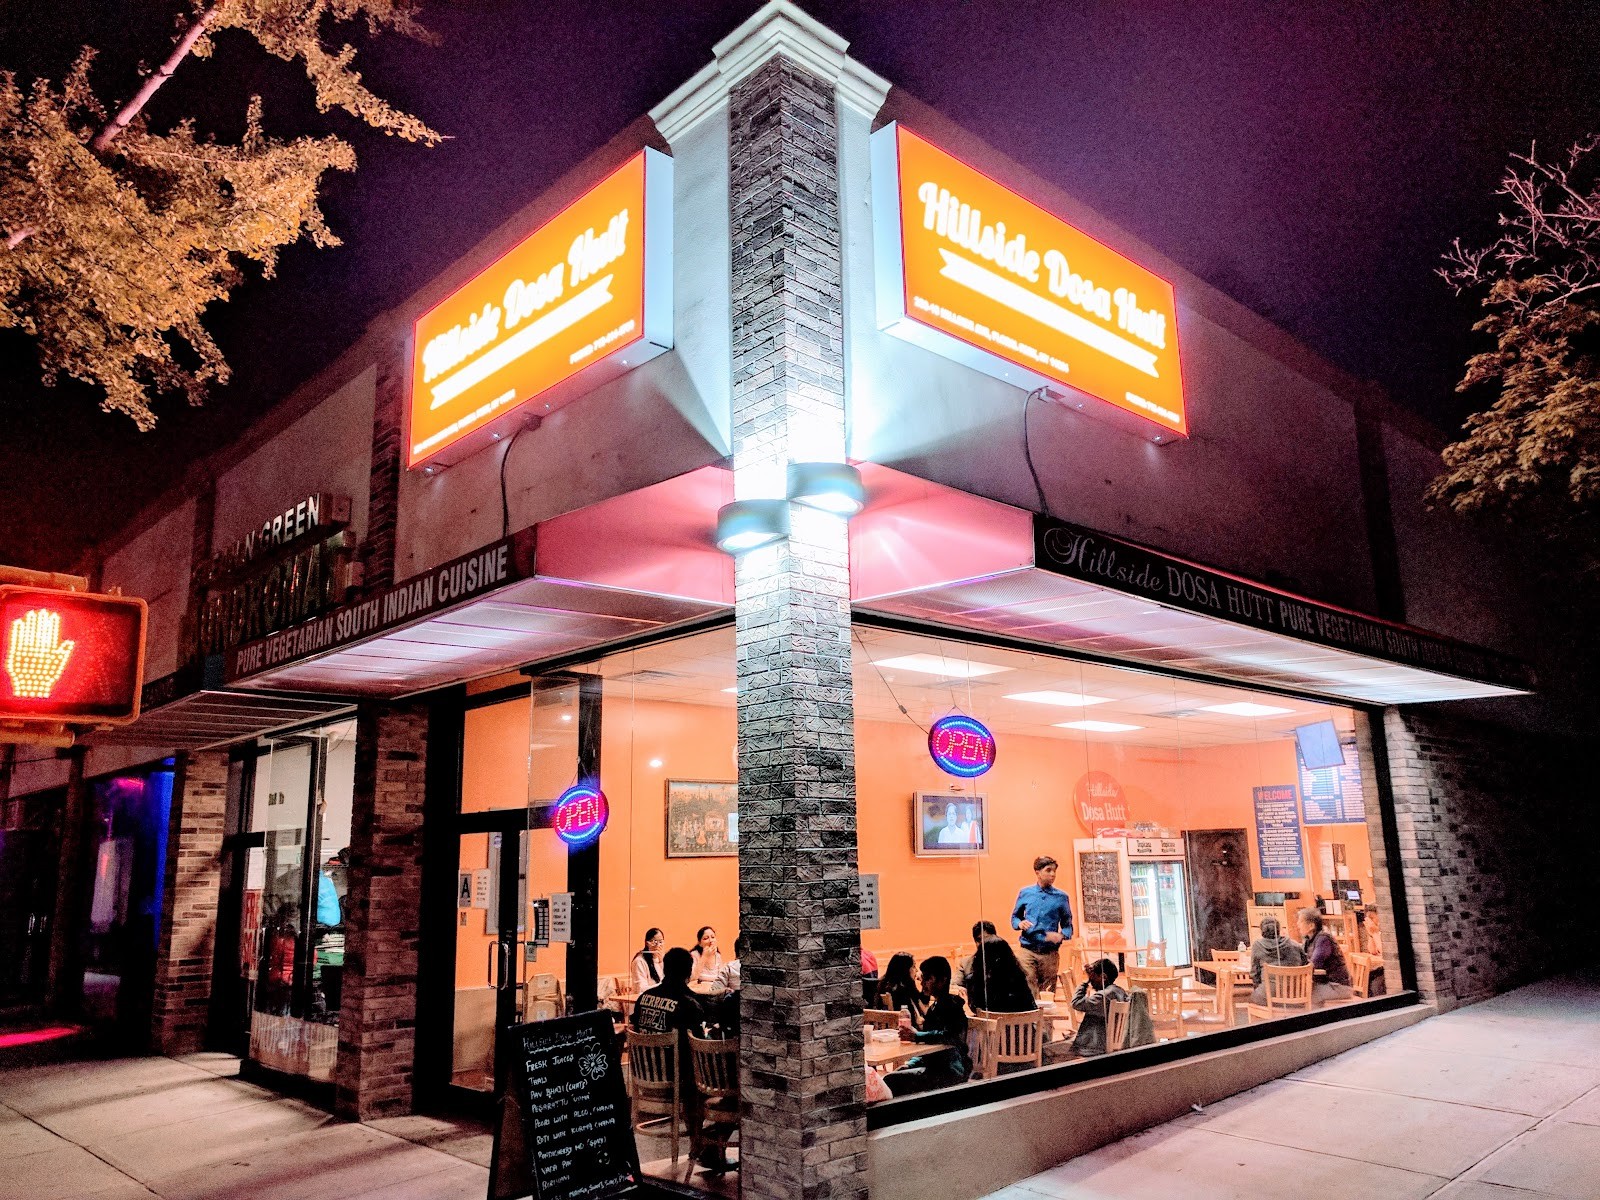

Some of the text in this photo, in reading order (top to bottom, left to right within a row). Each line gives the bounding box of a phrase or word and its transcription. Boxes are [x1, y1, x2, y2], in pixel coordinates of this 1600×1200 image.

[918, 182, 1166, 349] Hillside Dosa Hutt
[259, 492, 321, 549] GREEN
[236, 544, 509, 675] PURE VEGETARIAN SOUTH INDIAN CUISINE
[1043, 527, 1164, 592] Hillside
[1165, 565, 1221, 609] DOSA
[1226, 584, 1274, 624] HUTT
[1279, 600, 1315, 635] PURE
[1315, 610, 1384, 651] VEGETARIAN
[1385, 629, 1420, 660] SOUTH
[936, 728, 991, 766] OPEN
[556, 797, 599, 832] OPEN
[1081, 802, 1127, 822] Dosa Hutt
[526, 1053, 574, 1073] FRESH JUICES
[530, 1090, 542, 1100] PAV
[553, 1114, 568, 1124] WITH
